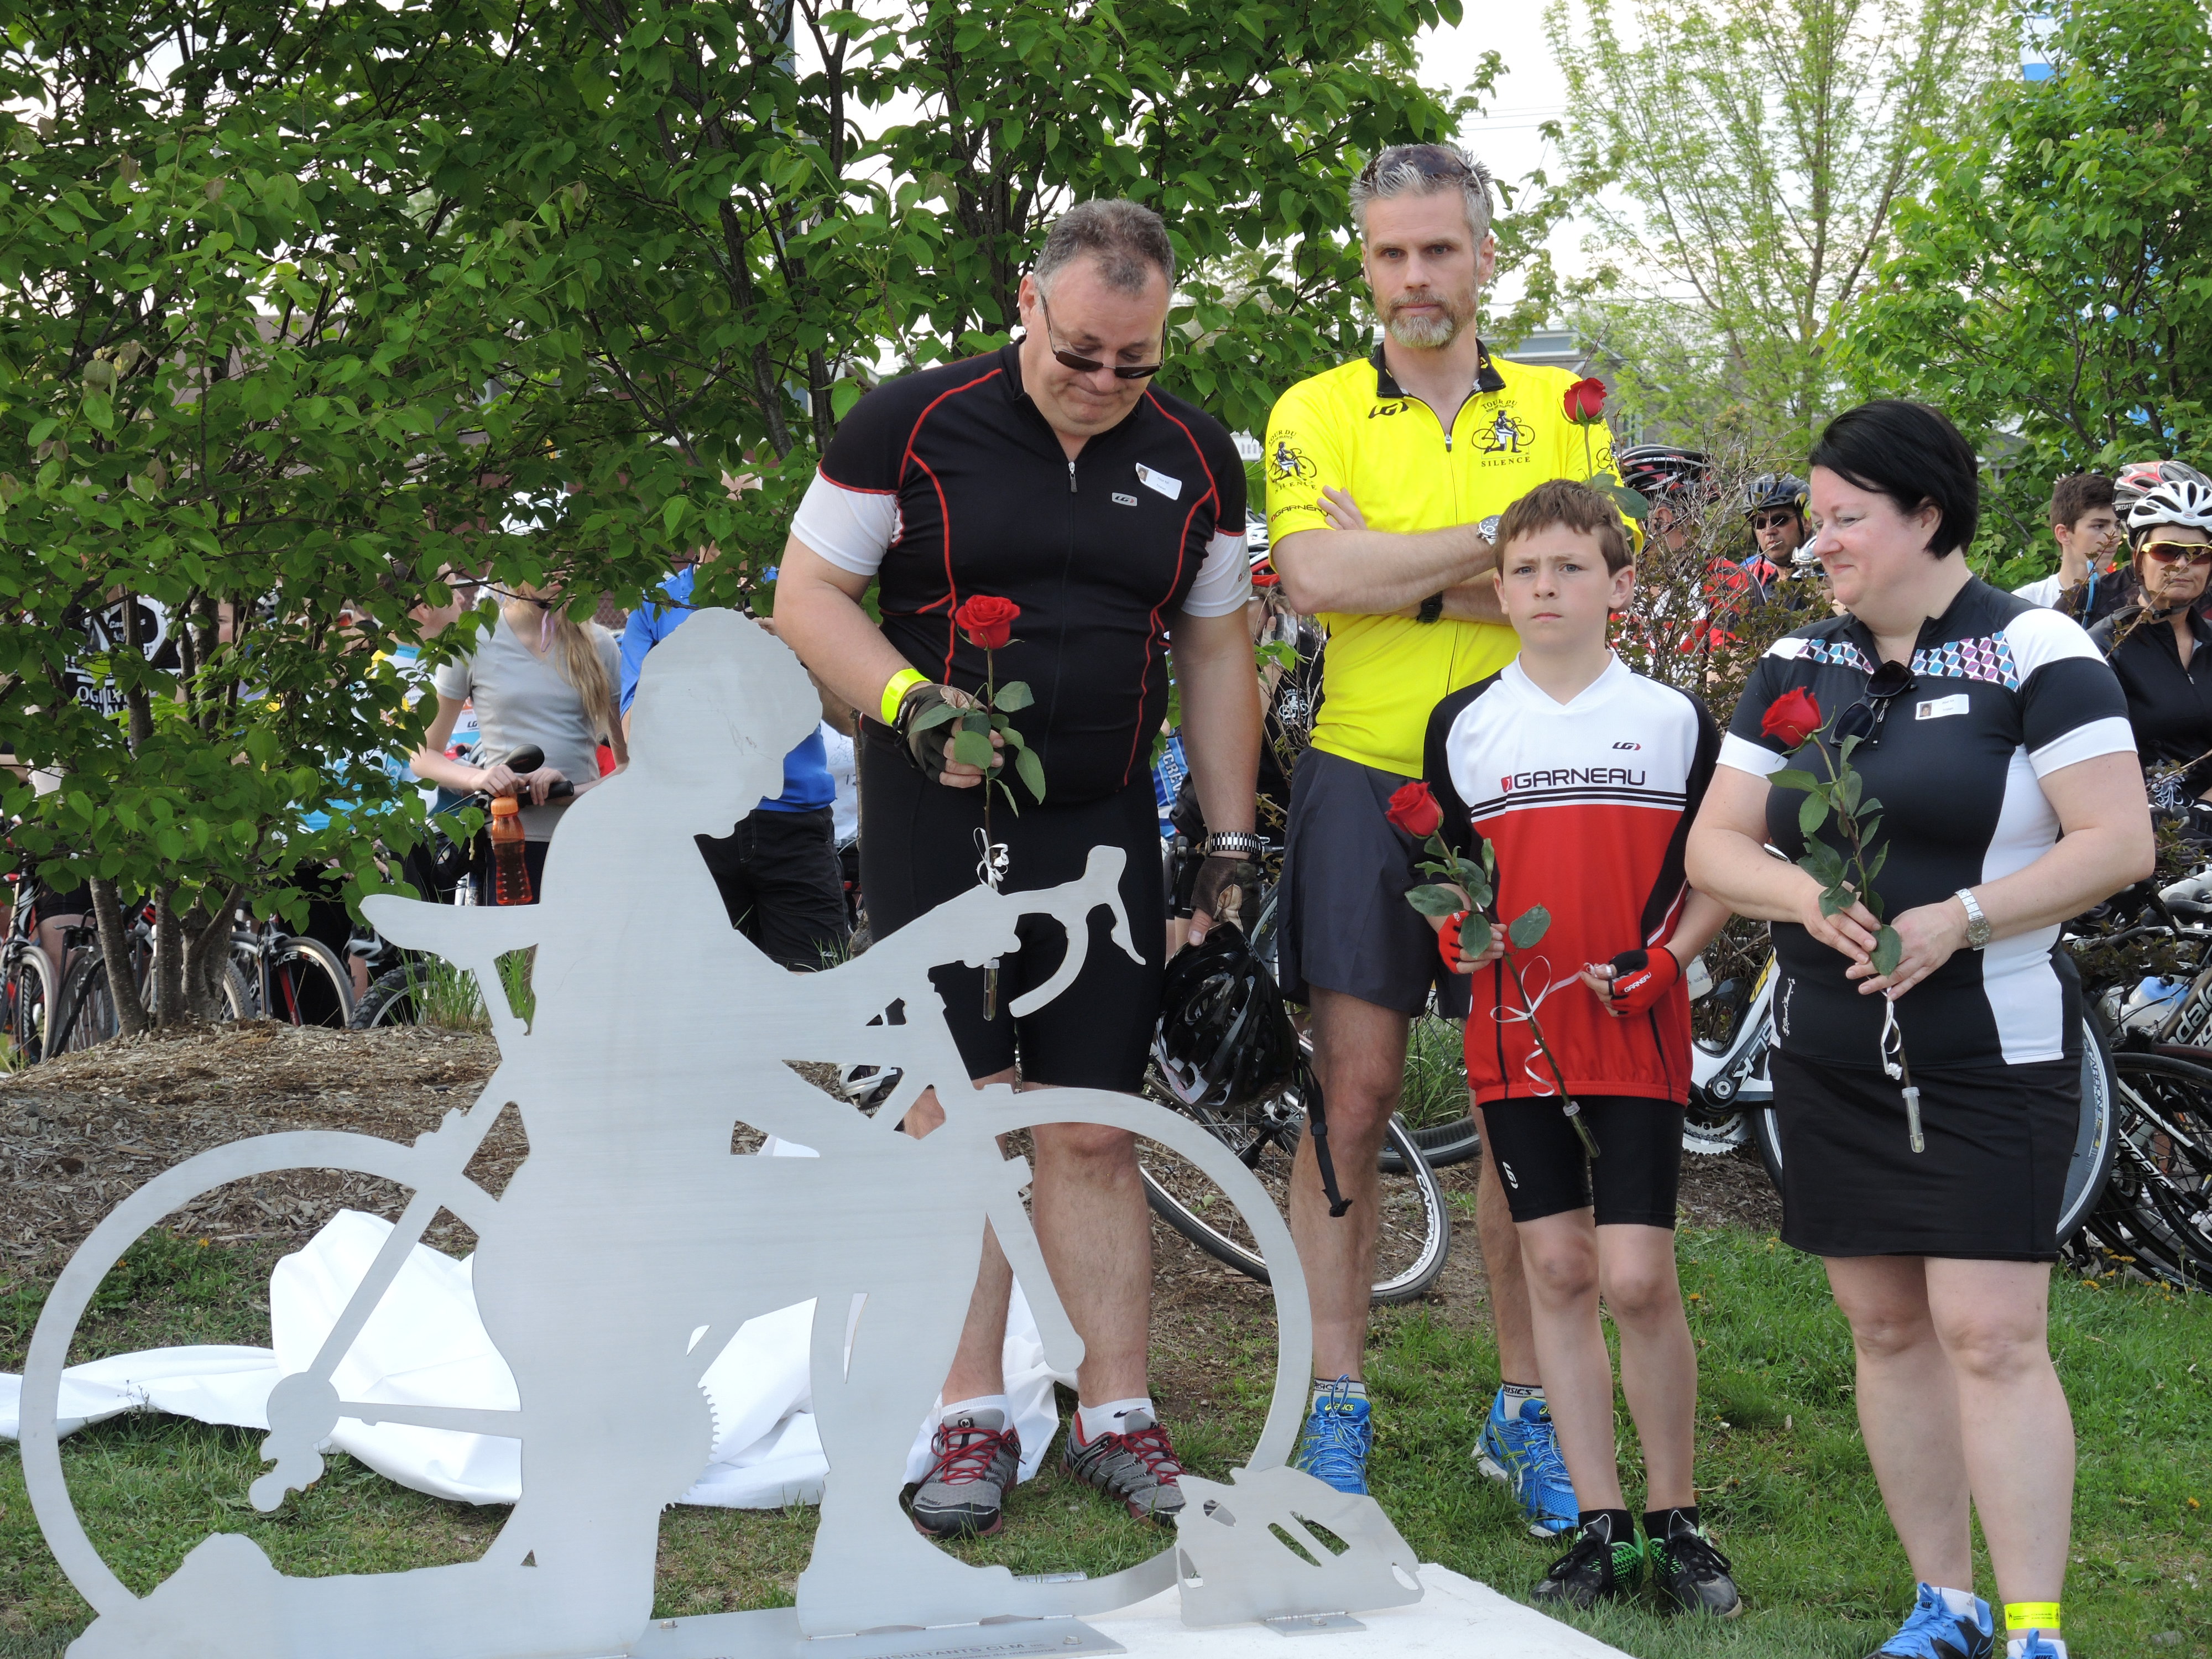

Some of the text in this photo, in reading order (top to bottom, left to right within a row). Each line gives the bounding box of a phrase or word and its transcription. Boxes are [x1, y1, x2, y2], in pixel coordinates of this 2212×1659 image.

[1481, 399, 1504, 409] TOUR
[1269, 430, 1283, 445] TOUR
[1481, 456, 1531, 467] SILENCE
[1275, 480, 1317, 494] SILENCE
[1514, 768, 1646, 789] GARNEAU
[986, 1643, 1025, 1651] CLM
